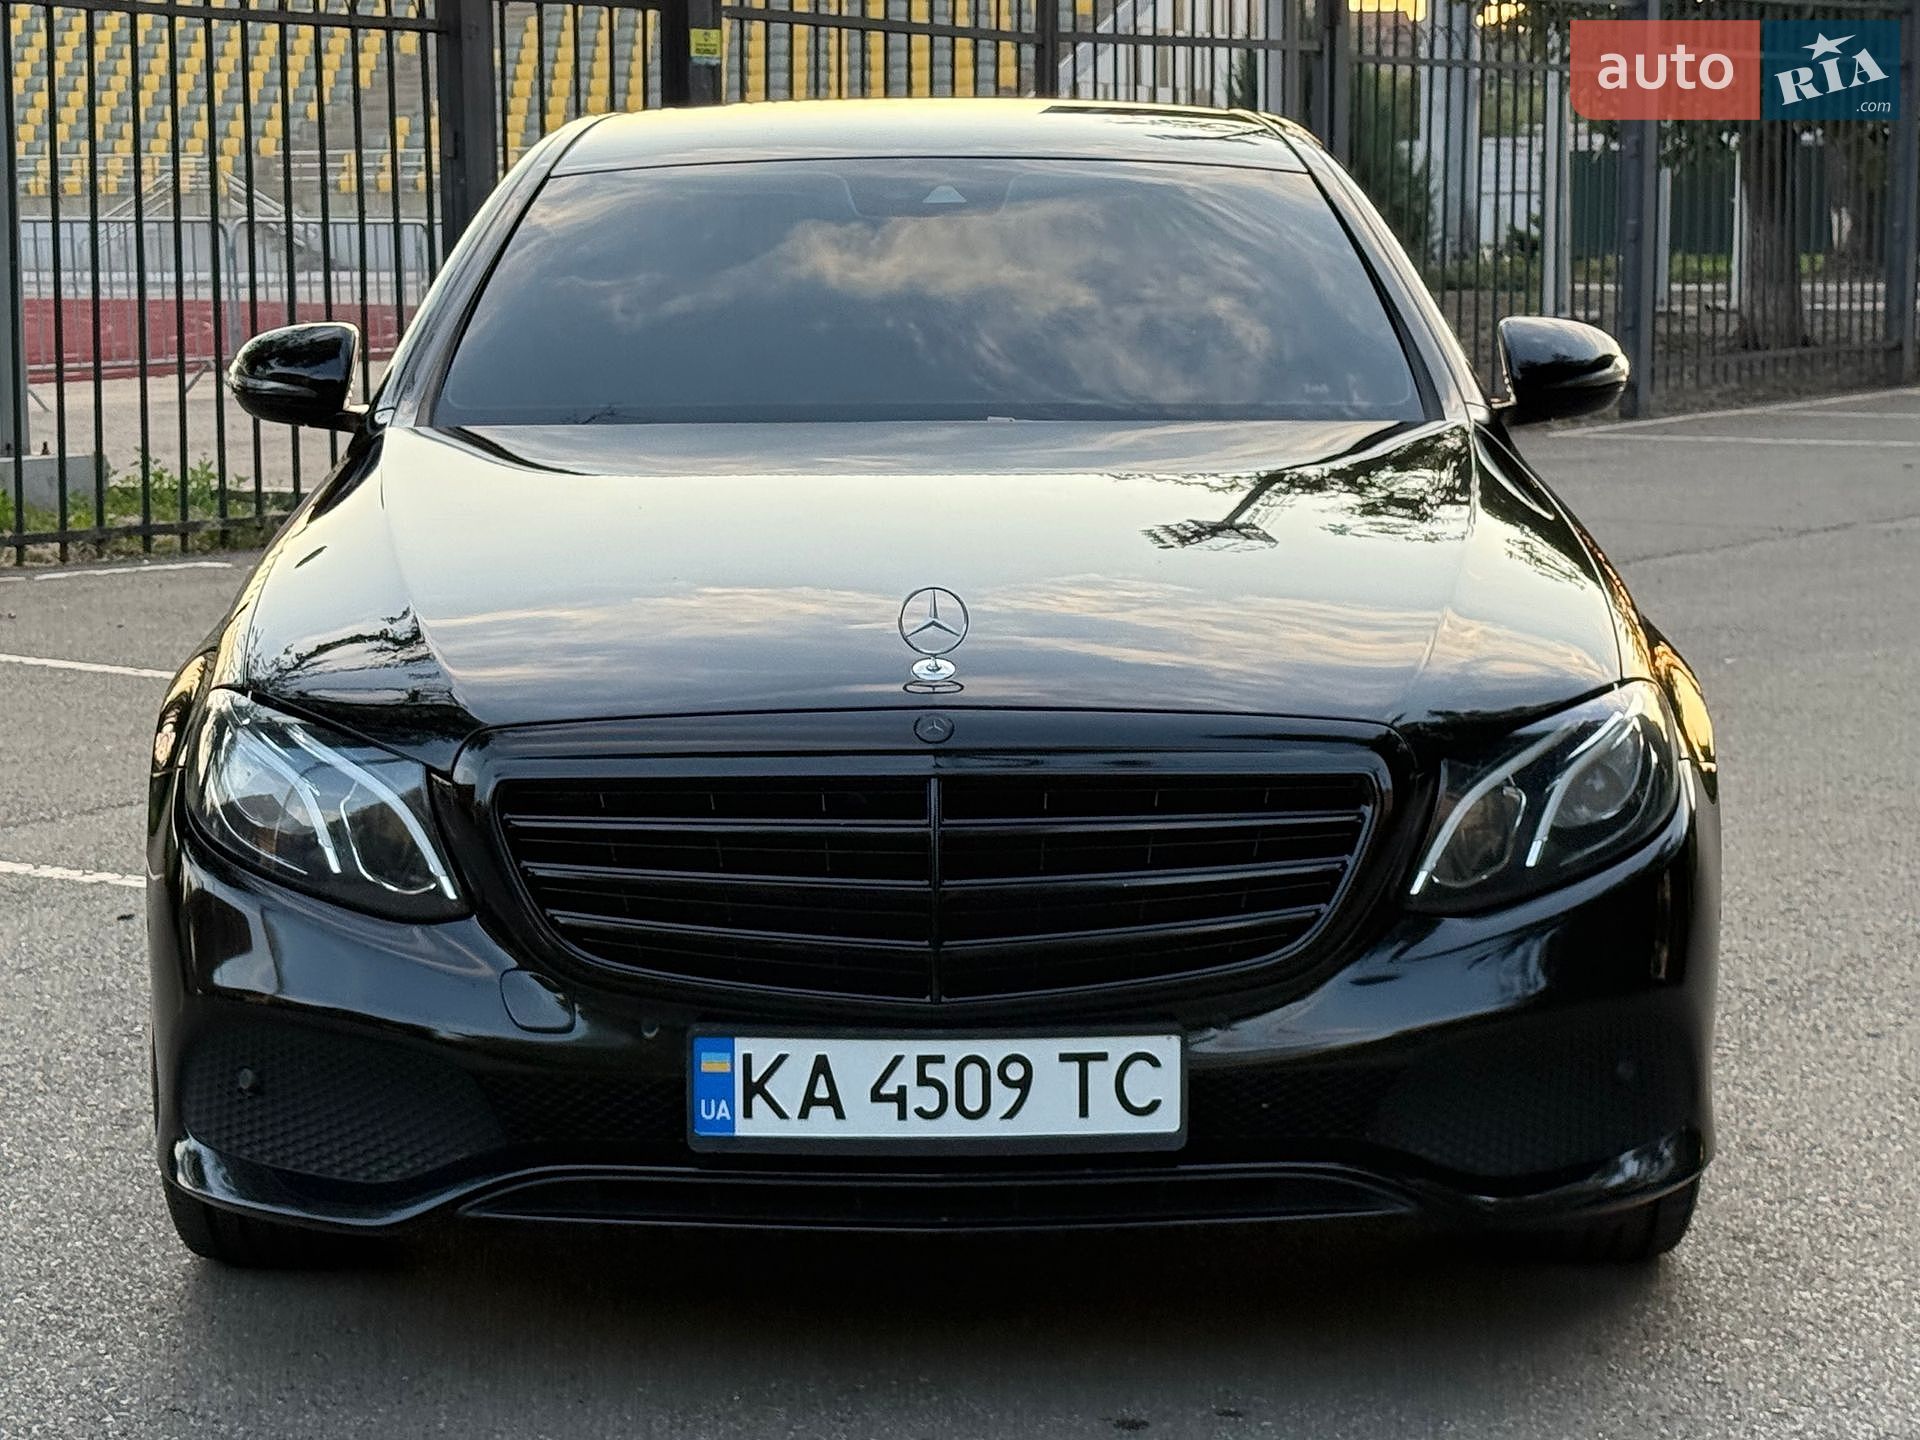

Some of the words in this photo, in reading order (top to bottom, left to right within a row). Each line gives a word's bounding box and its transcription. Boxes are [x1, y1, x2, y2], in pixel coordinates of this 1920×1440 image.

[742, 1052, 846, 1120] KA
[870, 1053, 1034, 1121] 4509
[1058, 1051, 1163, 1118] TC
[701, 1099, 732, 1121] UA
